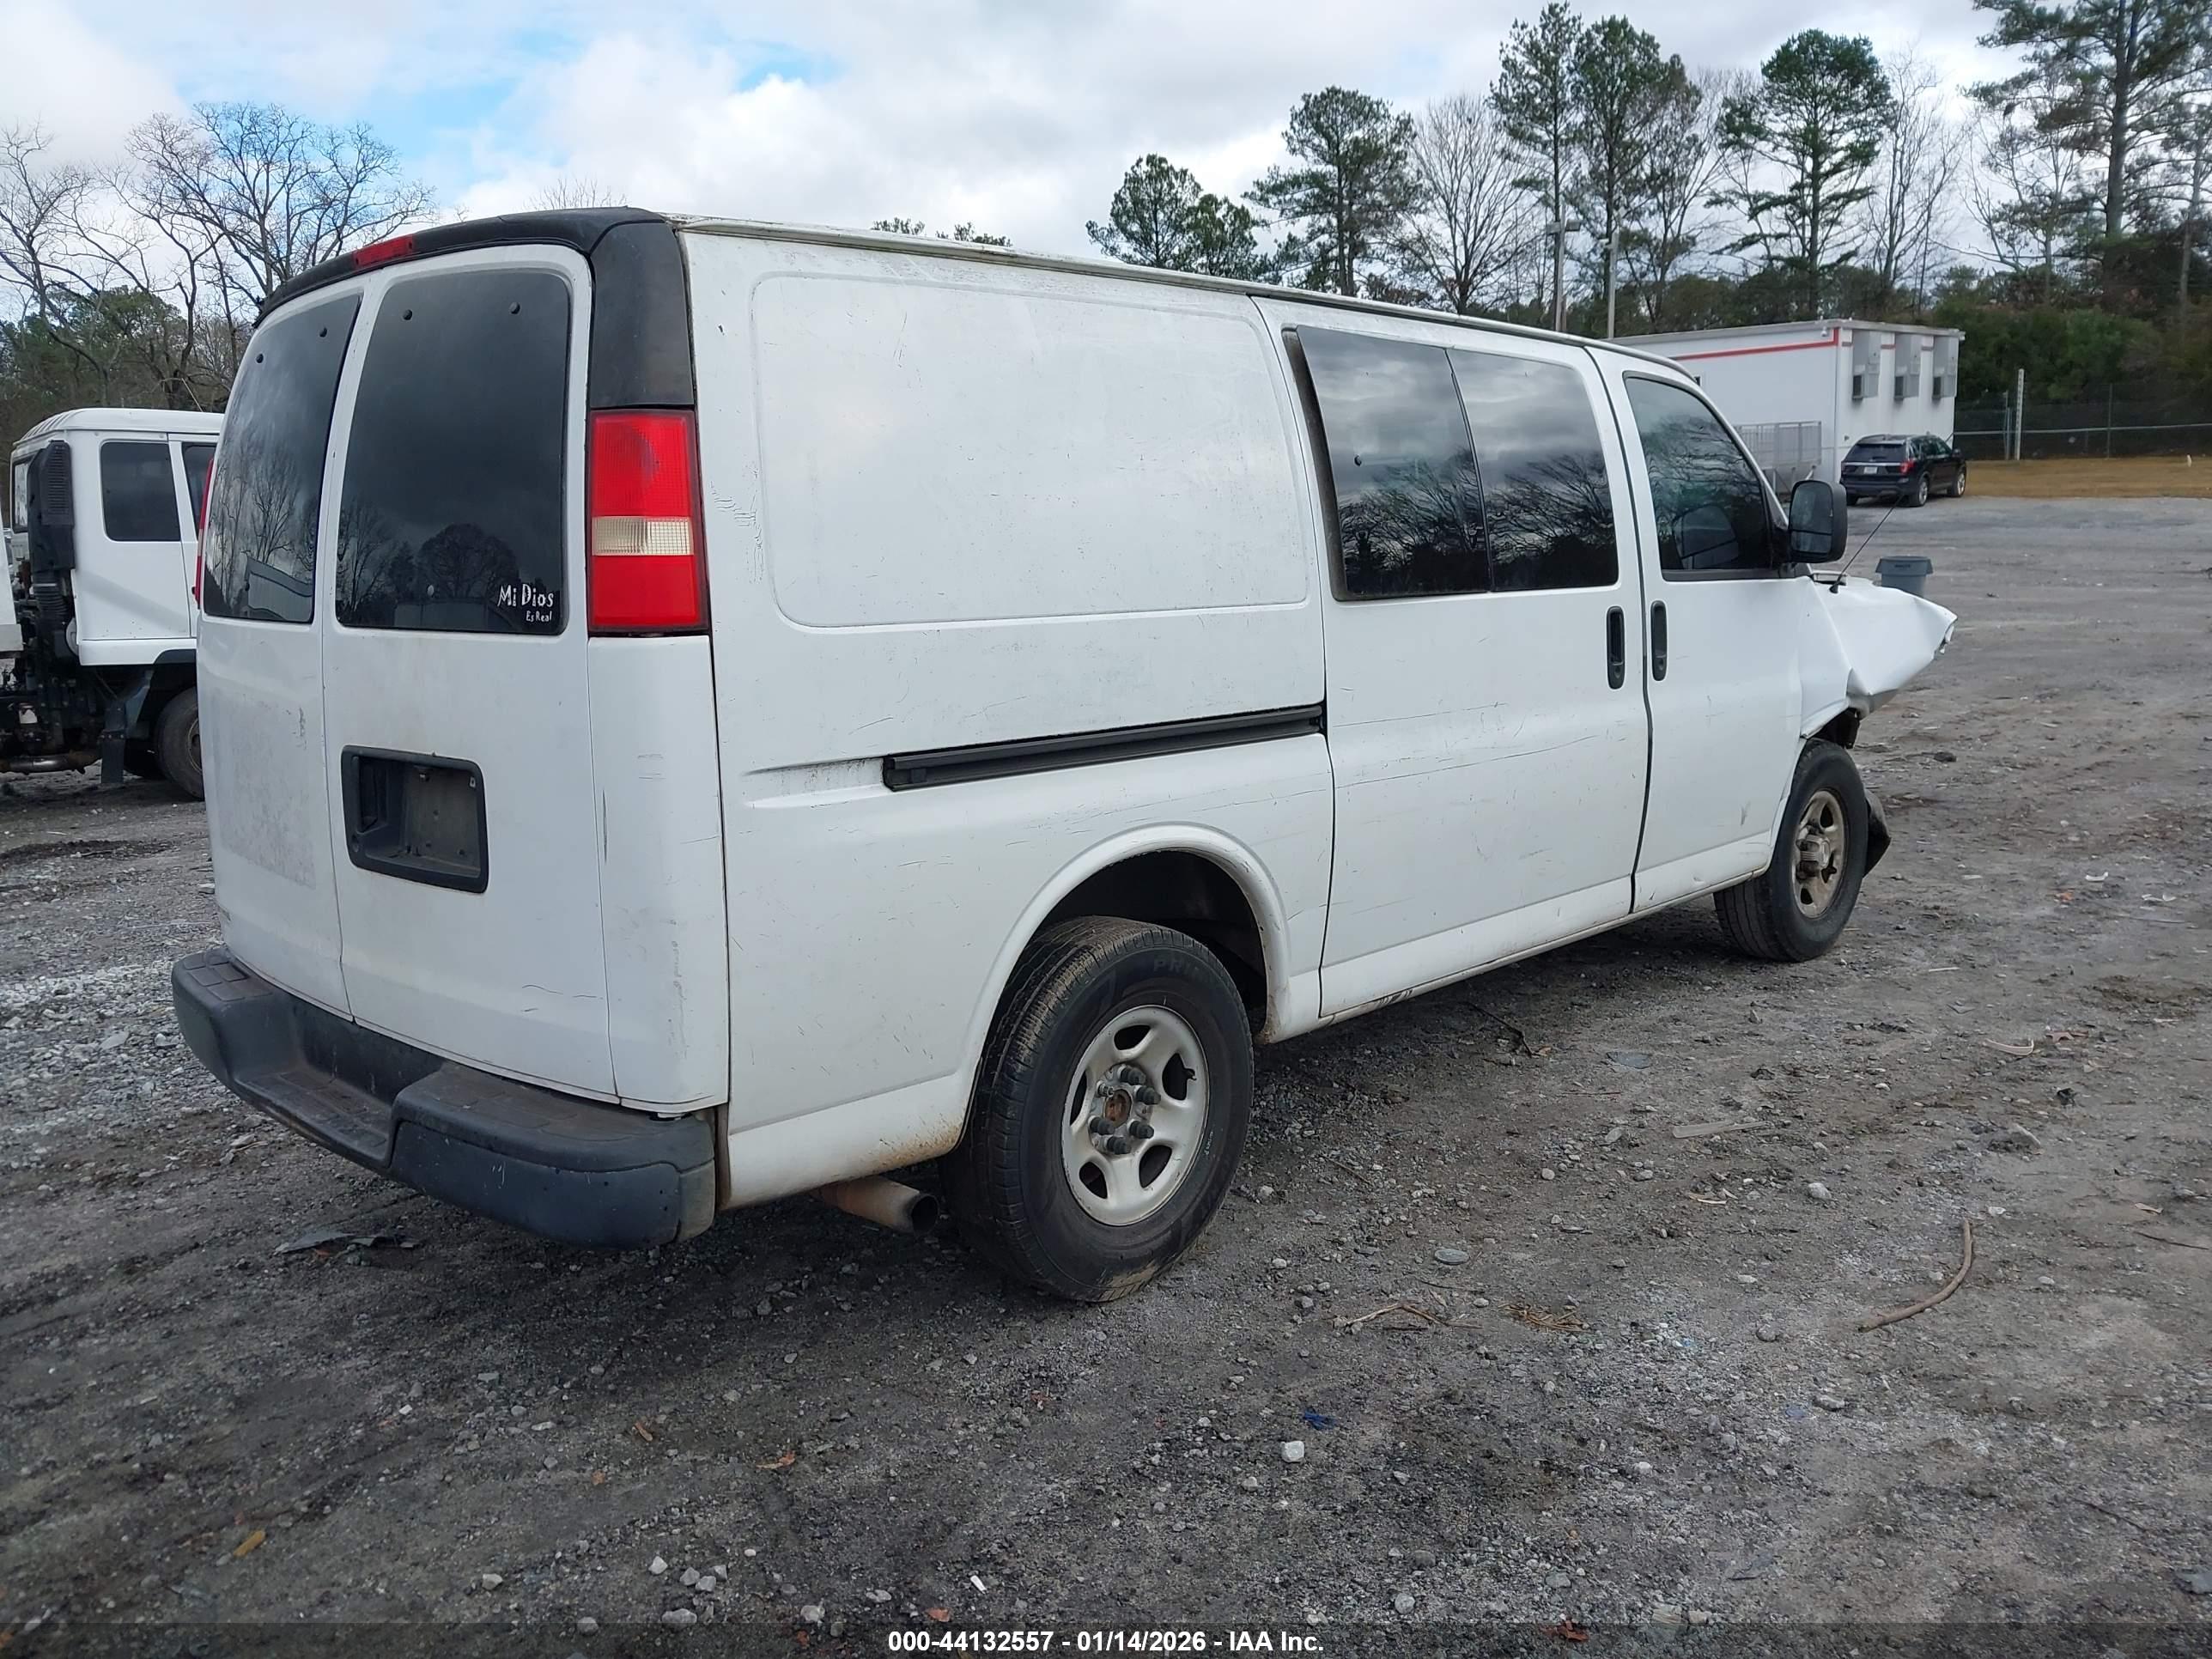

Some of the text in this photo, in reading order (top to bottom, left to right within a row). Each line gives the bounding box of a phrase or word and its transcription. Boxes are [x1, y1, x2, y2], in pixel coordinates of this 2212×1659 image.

[497, 584, 554, 608] Mi Dios
[526, 611, 552, 623] Es Real
